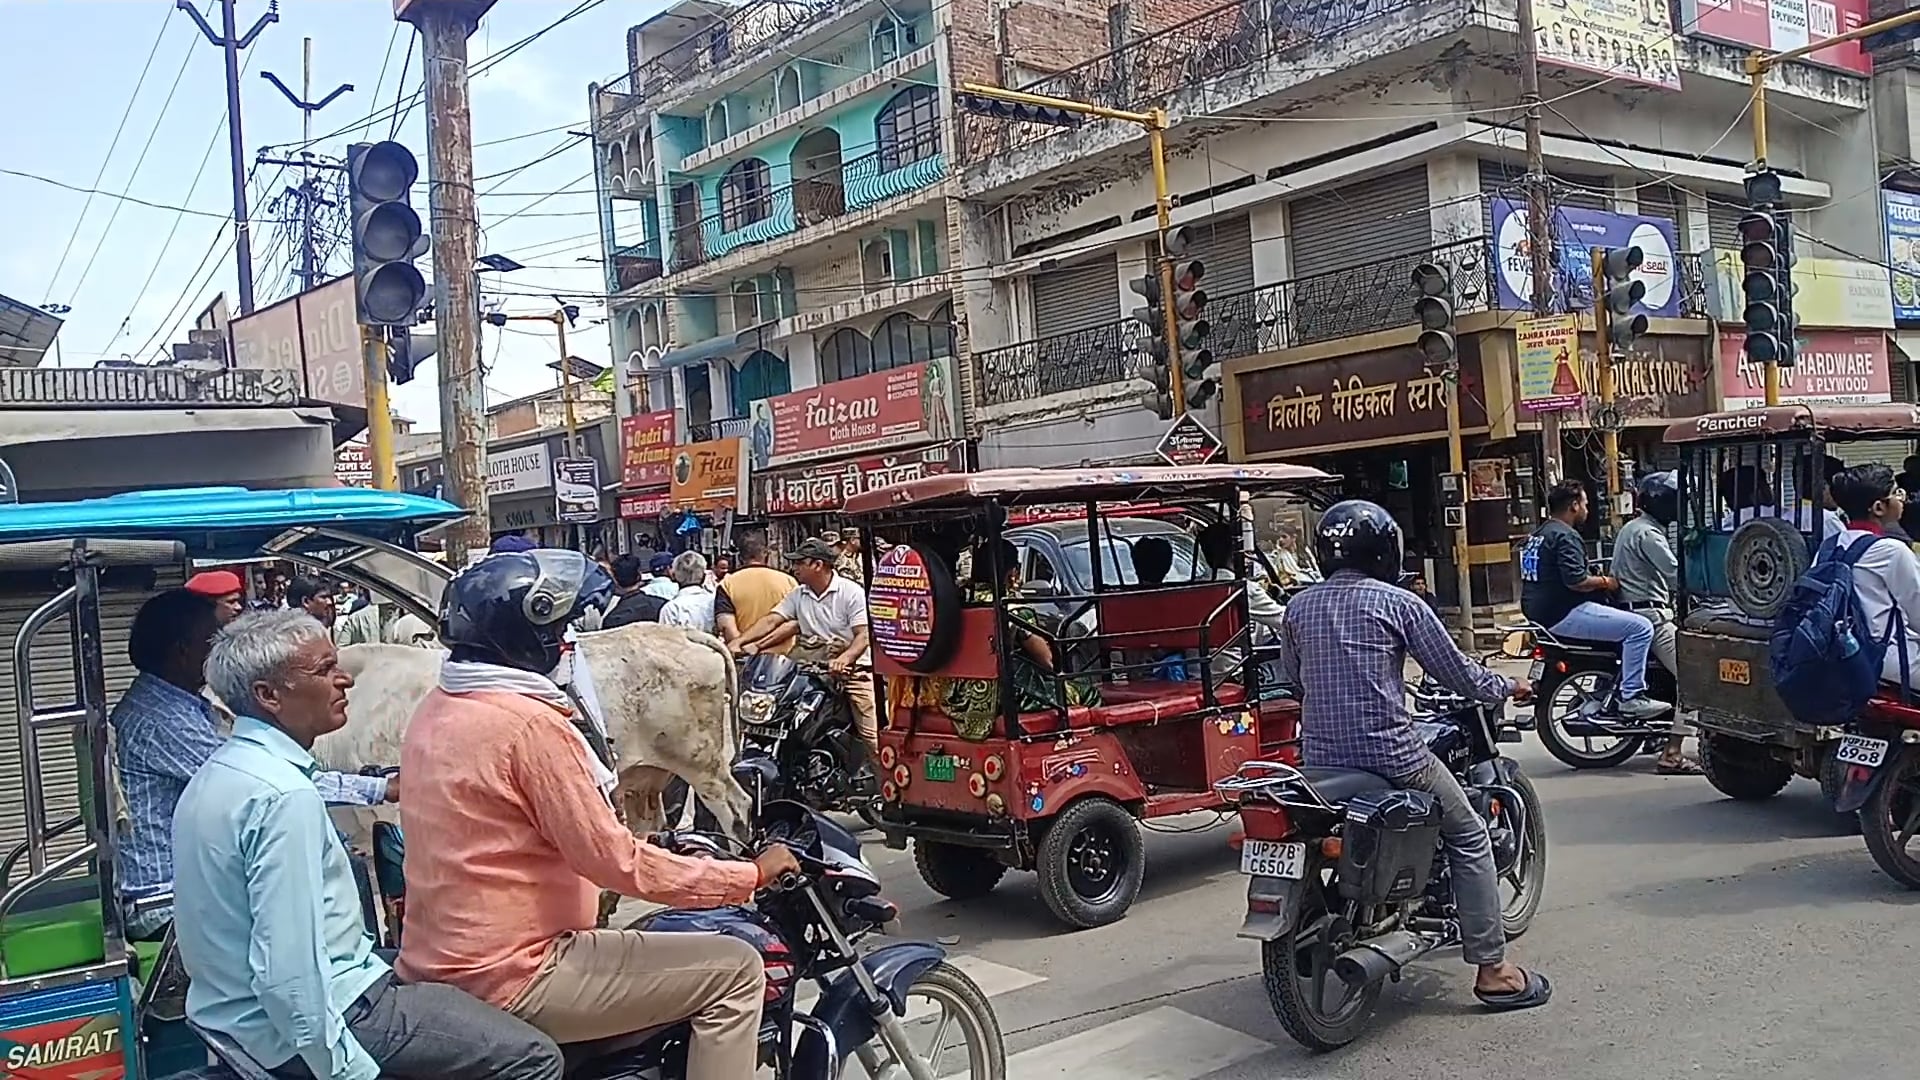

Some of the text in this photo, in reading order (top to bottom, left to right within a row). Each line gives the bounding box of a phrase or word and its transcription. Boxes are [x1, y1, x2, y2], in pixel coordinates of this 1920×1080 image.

[1779, 11, 1806, 28] PLYWOOD
[1518, 327, 1574, 341] ZAHRA FABRIC
[1797, 352, 1874, 376] HARDWARE
[1648, 359, 1690, 395] STORE
[1806, 376, 1868, 393] & PLYWOOD
[805, 393, 880, 429] Faizan
[1267, 385, 1323, 432] त्रिलोक
[1331, 374, 1398, 423] मेडिकल
[829, 424, 850, 441] Cloth
[851, 422, 877, 437] House
[1696, 411, 1768, 432] Panther
[633, 426, 662, 447] Qadri
[511, 453, 541, 473] HOUSE
[626, 447, 671, 466] Perfume
[696, 451, 735, 478] Fiza
[786, 469, 839, 504] कॉटन
[840, 463, 863, 499] ही
[1252, 842, 1296, 860] UP27B
[1250, 858, 1295, 876] C6504
[6, 1027, 120, 1071] SAMRAT
